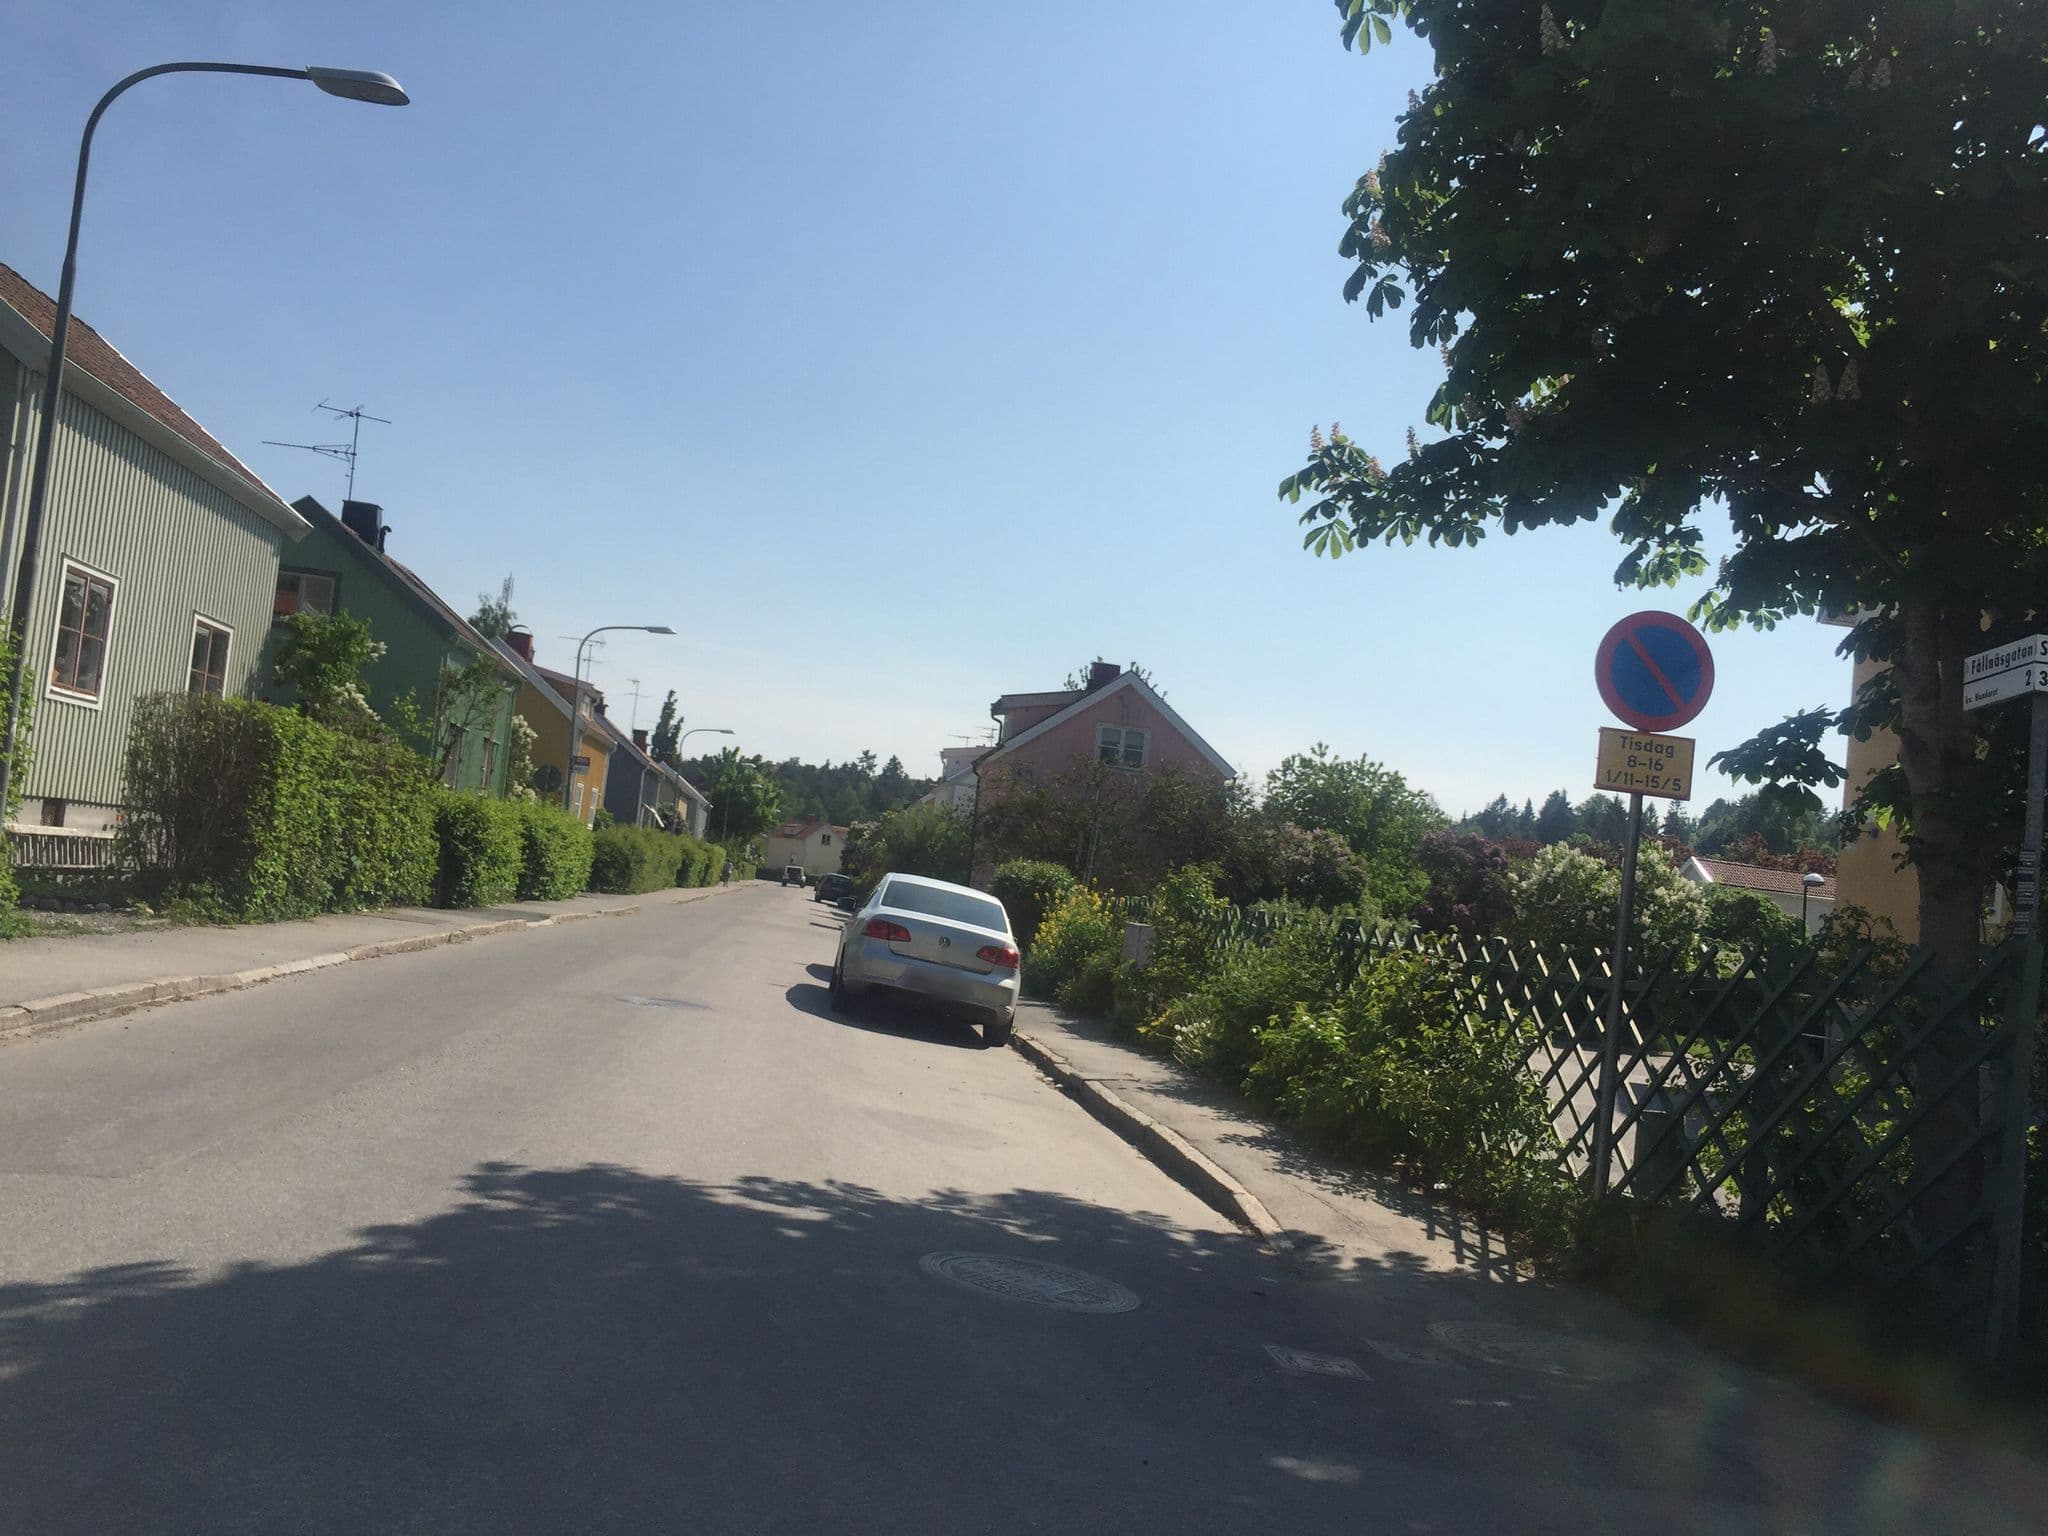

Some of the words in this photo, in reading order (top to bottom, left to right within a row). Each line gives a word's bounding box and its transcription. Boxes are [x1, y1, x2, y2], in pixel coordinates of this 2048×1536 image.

[2025, 670, 2032, 686] 2
[2039, 671, 2048, 686] 3
[1620, 736, 1675, 758] Tisdag
[1627, 754, 1664, 772] 8-16
[1607, 770, 1681, 791] 1/11-15/5
